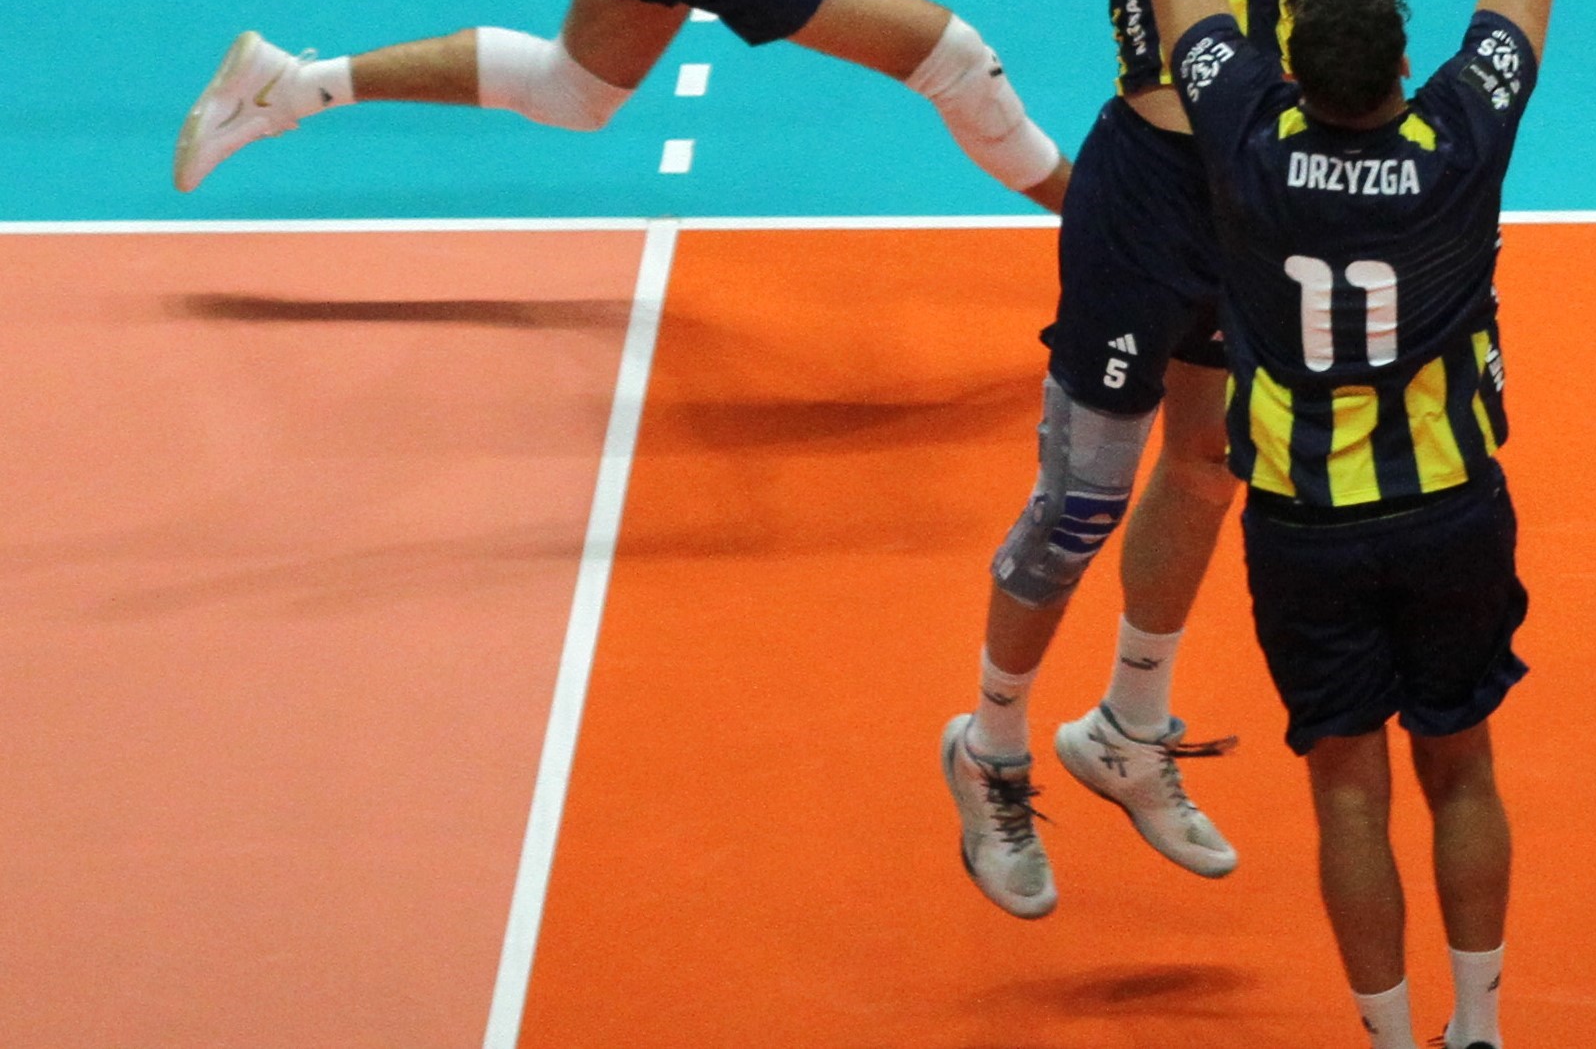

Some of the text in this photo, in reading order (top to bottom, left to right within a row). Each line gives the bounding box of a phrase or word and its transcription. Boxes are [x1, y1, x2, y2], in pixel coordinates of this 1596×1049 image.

[1287, 151, 1421, 196] DRZYZGA
[1284, 255, 1398, 373] 11
[1103, 357, 1128, 389] 5
